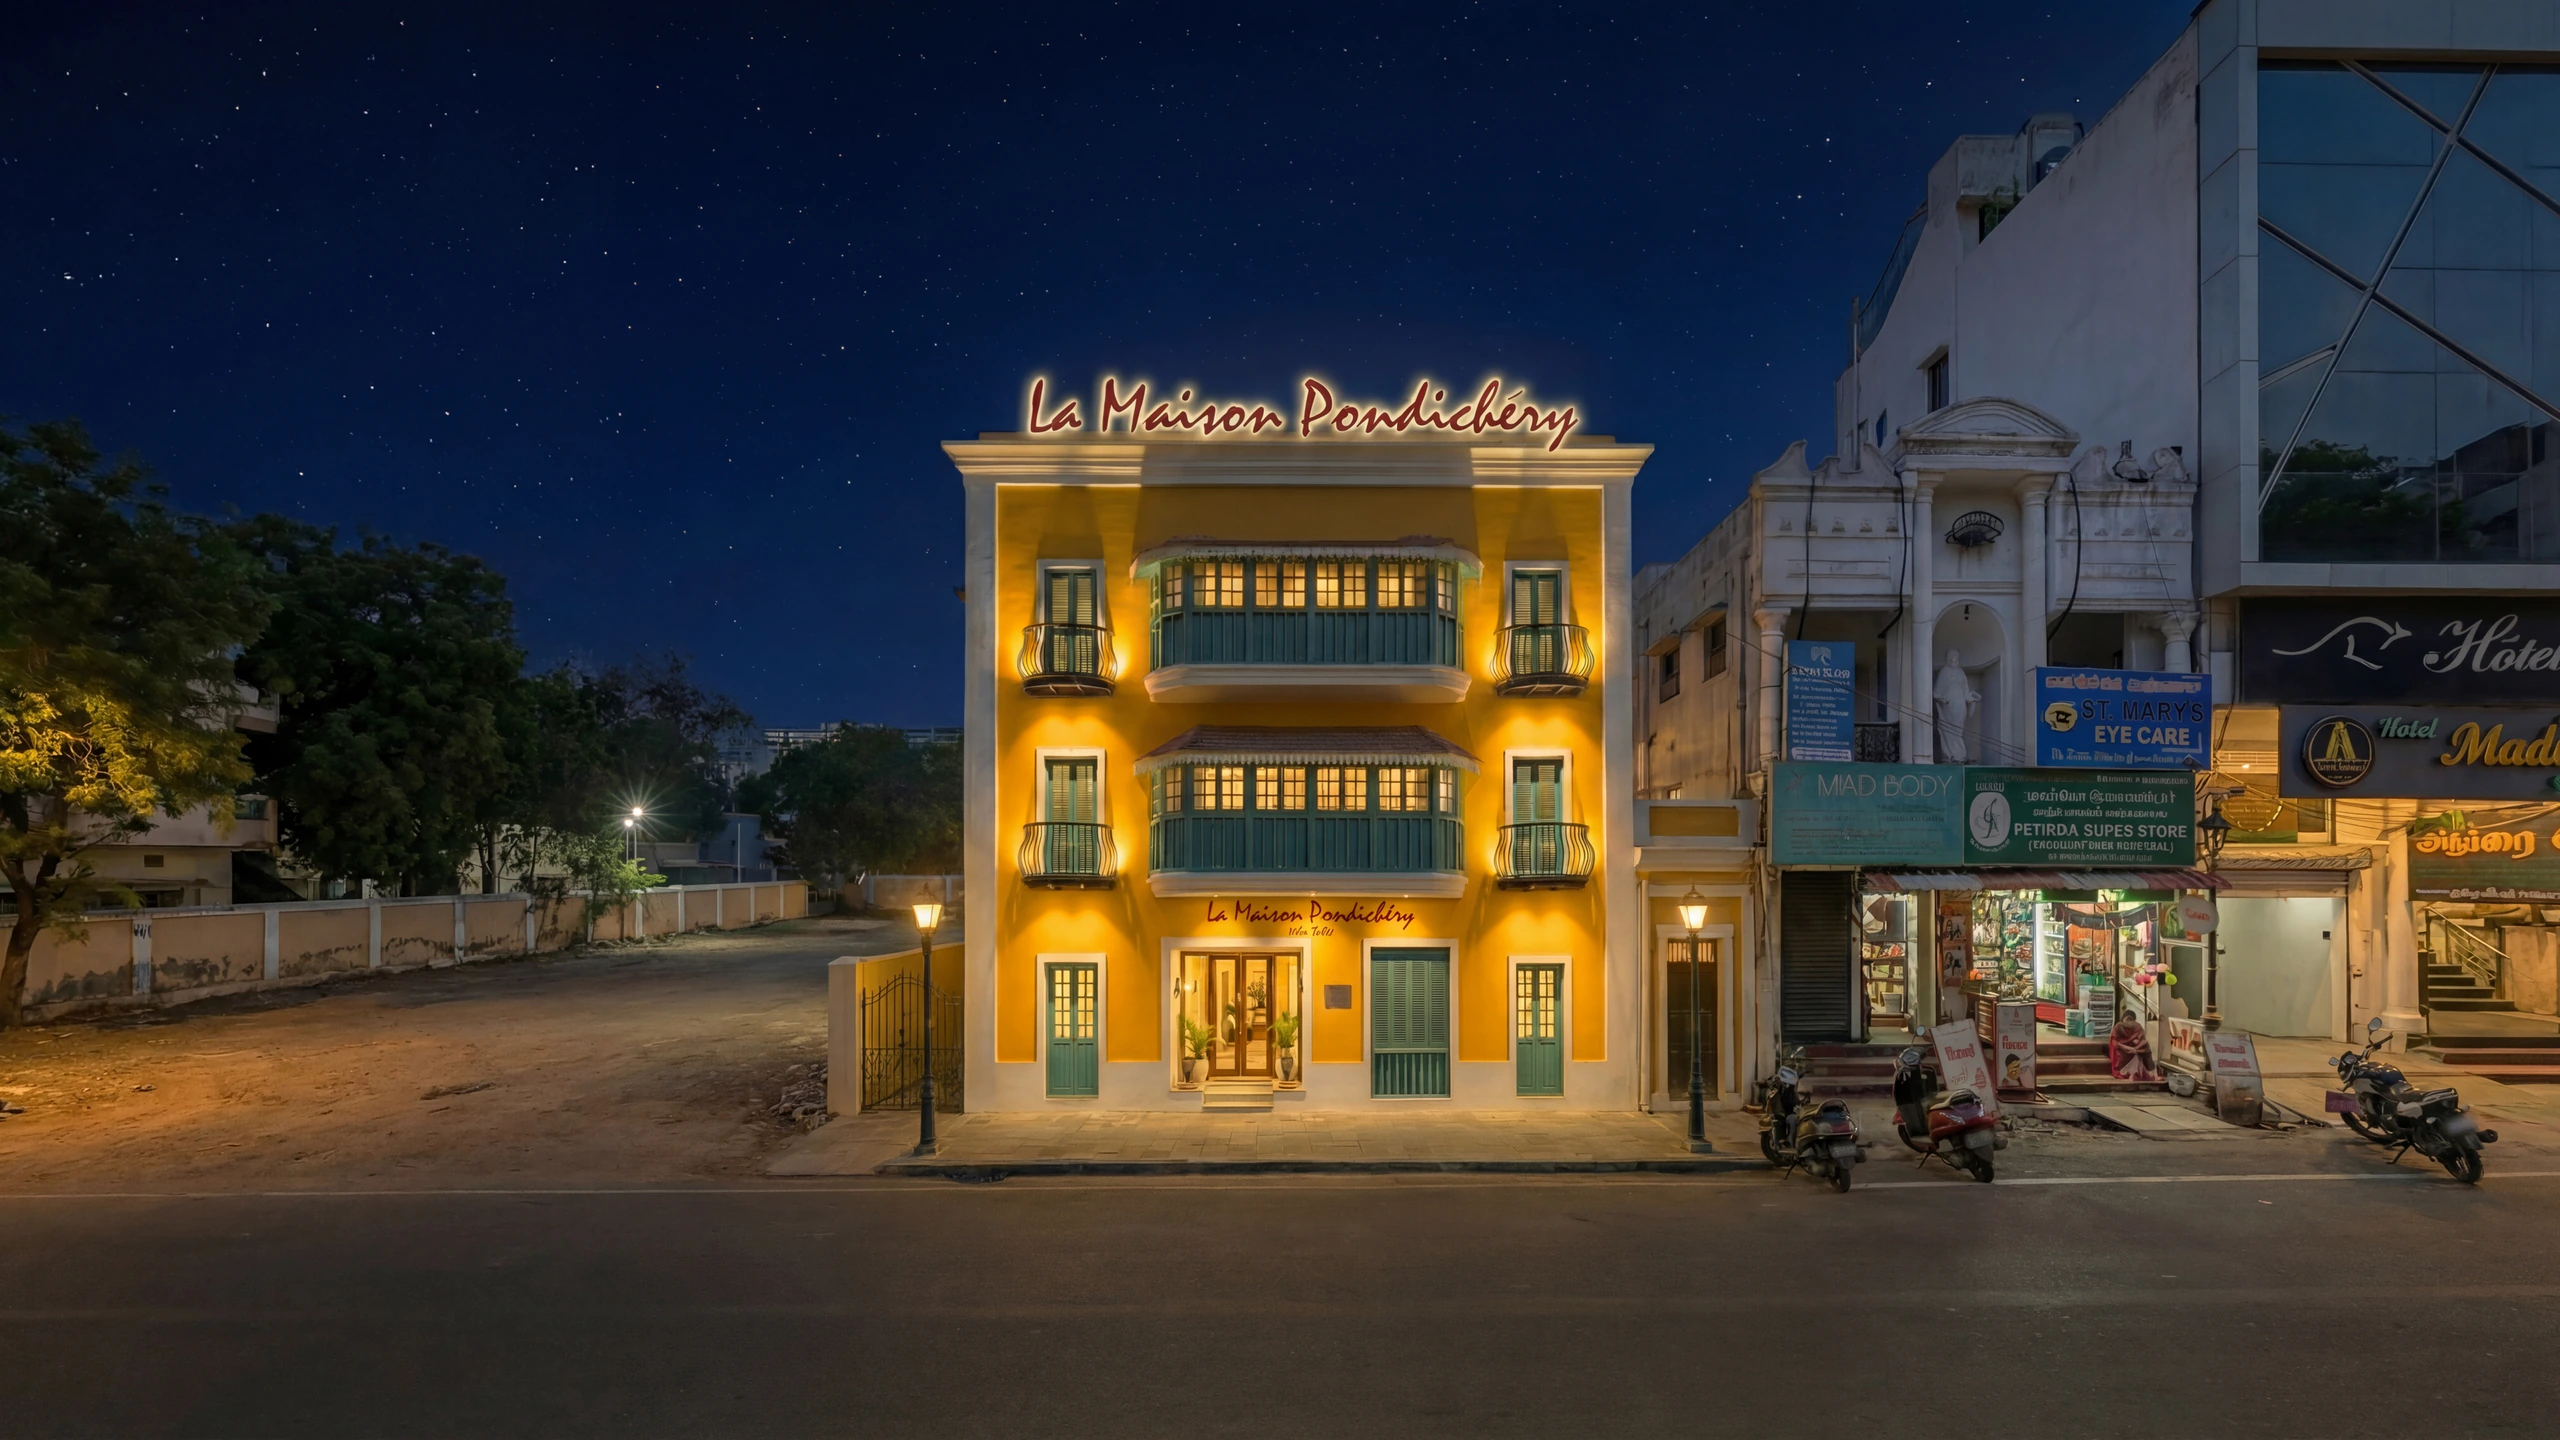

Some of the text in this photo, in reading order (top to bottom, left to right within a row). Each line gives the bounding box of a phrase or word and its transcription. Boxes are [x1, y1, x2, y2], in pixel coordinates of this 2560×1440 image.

[1030, 378, 1579, 452] La Maison Pondichéry
[2081, 699, 2205, 723] ST. MARY'S
[2094, 725, 2191, 746] EYE CARE
[2380, 716, 2440, 739] Hotel
[1883, 774, 1953, 797] BODY
[2013, 822, 2188, 838] PETIRDA SUPES STORE
[1206, 899, 1416, 931] La Maison Pondichéry
